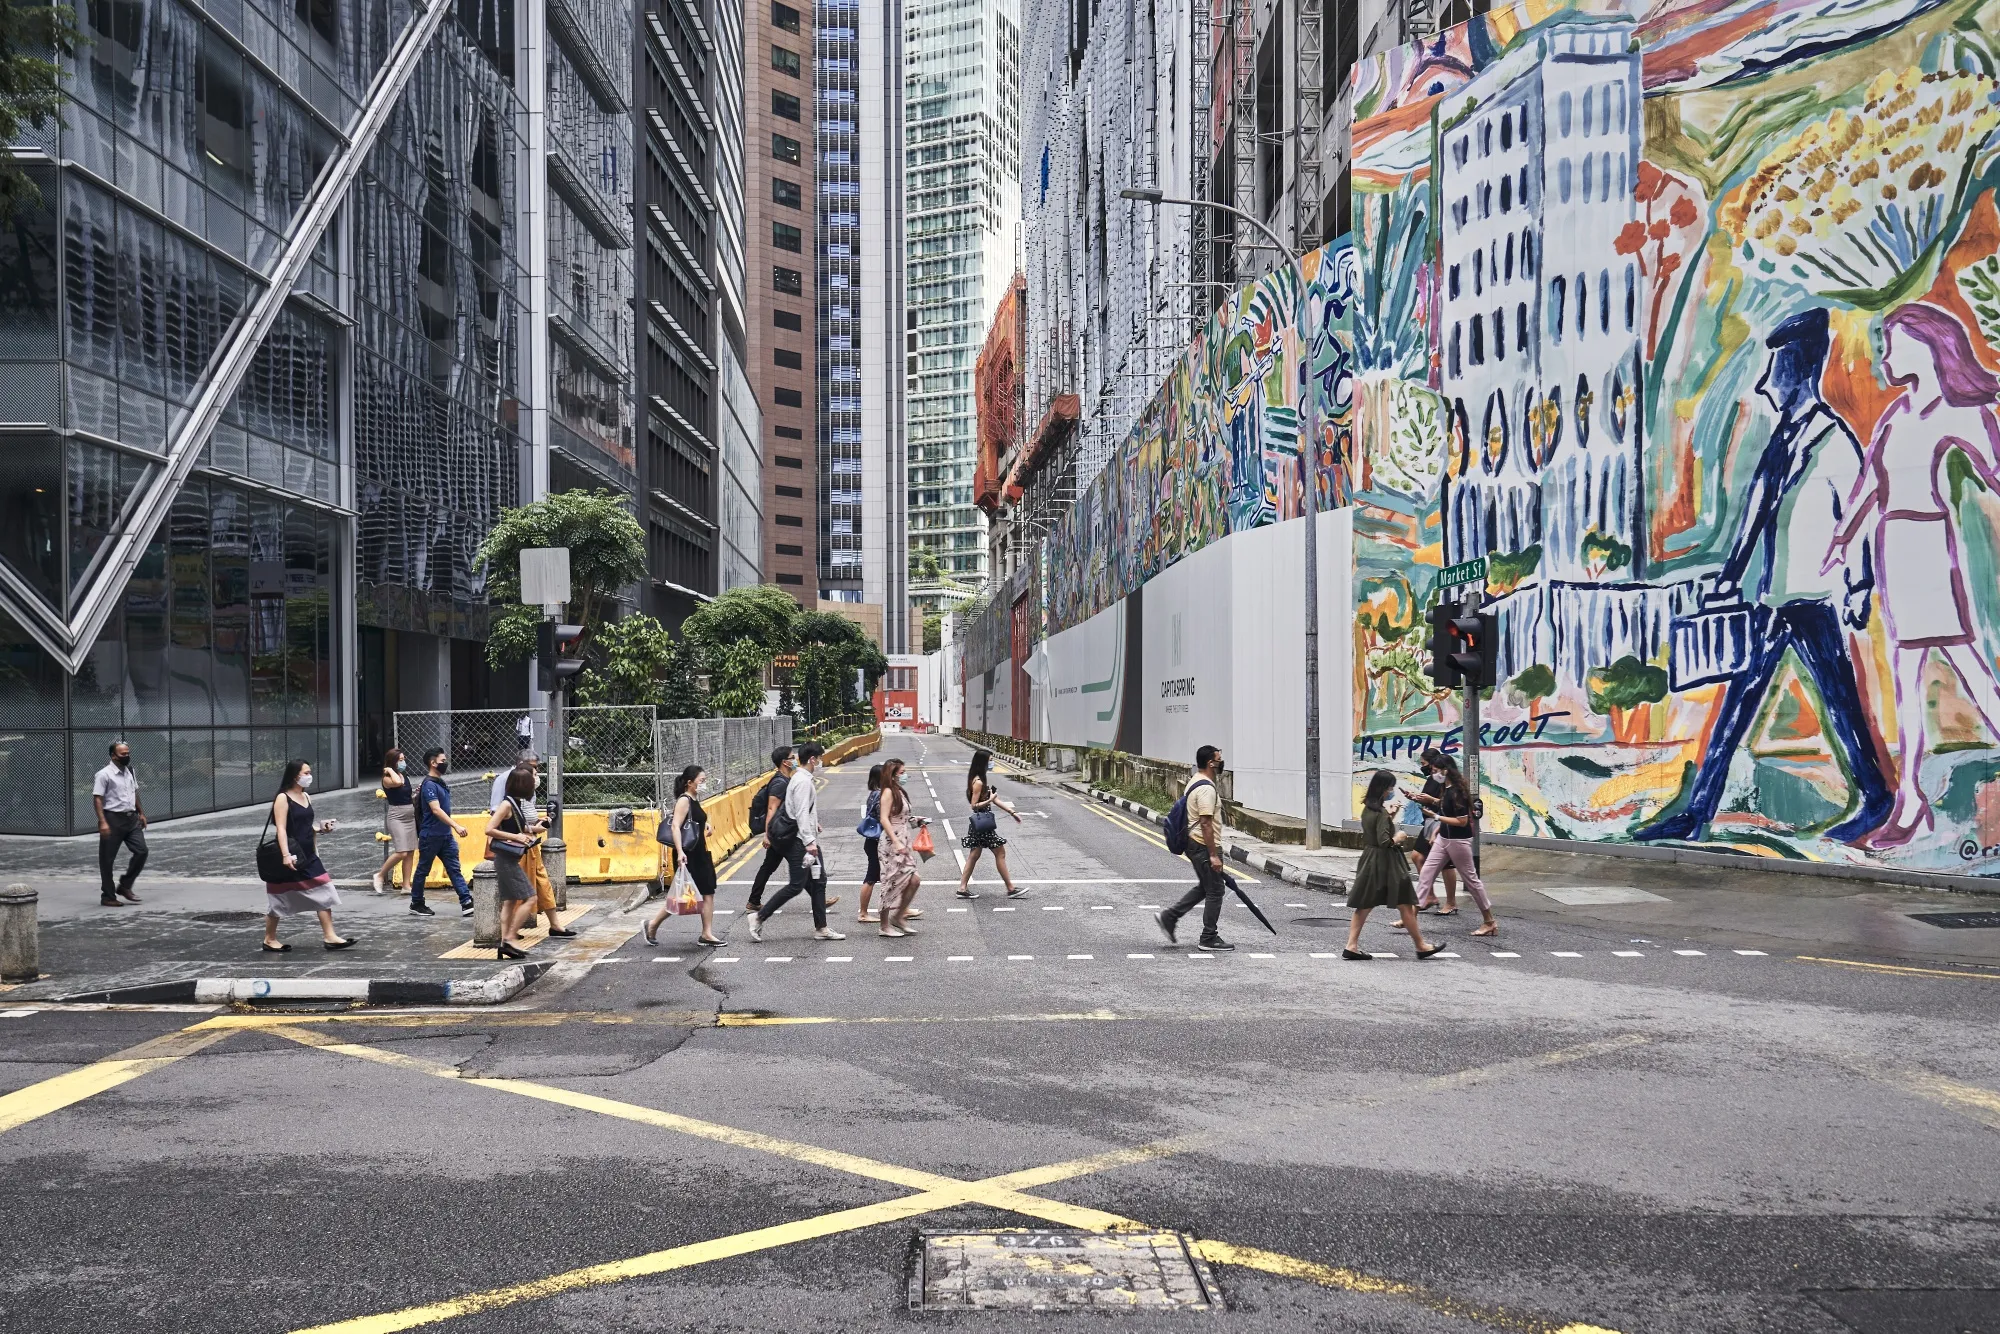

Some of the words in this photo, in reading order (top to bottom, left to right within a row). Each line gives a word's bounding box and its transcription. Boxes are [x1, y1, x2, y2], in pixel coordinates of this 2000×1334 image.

[1440, 566, 1469, 586] Market
[1473, 562, 1482, 578] St
[1161, 677, 1195, 699] CAPITASPRING
[1464, 699, 1470, 709] 3
[1959, 839, 1999, 860] @ri
